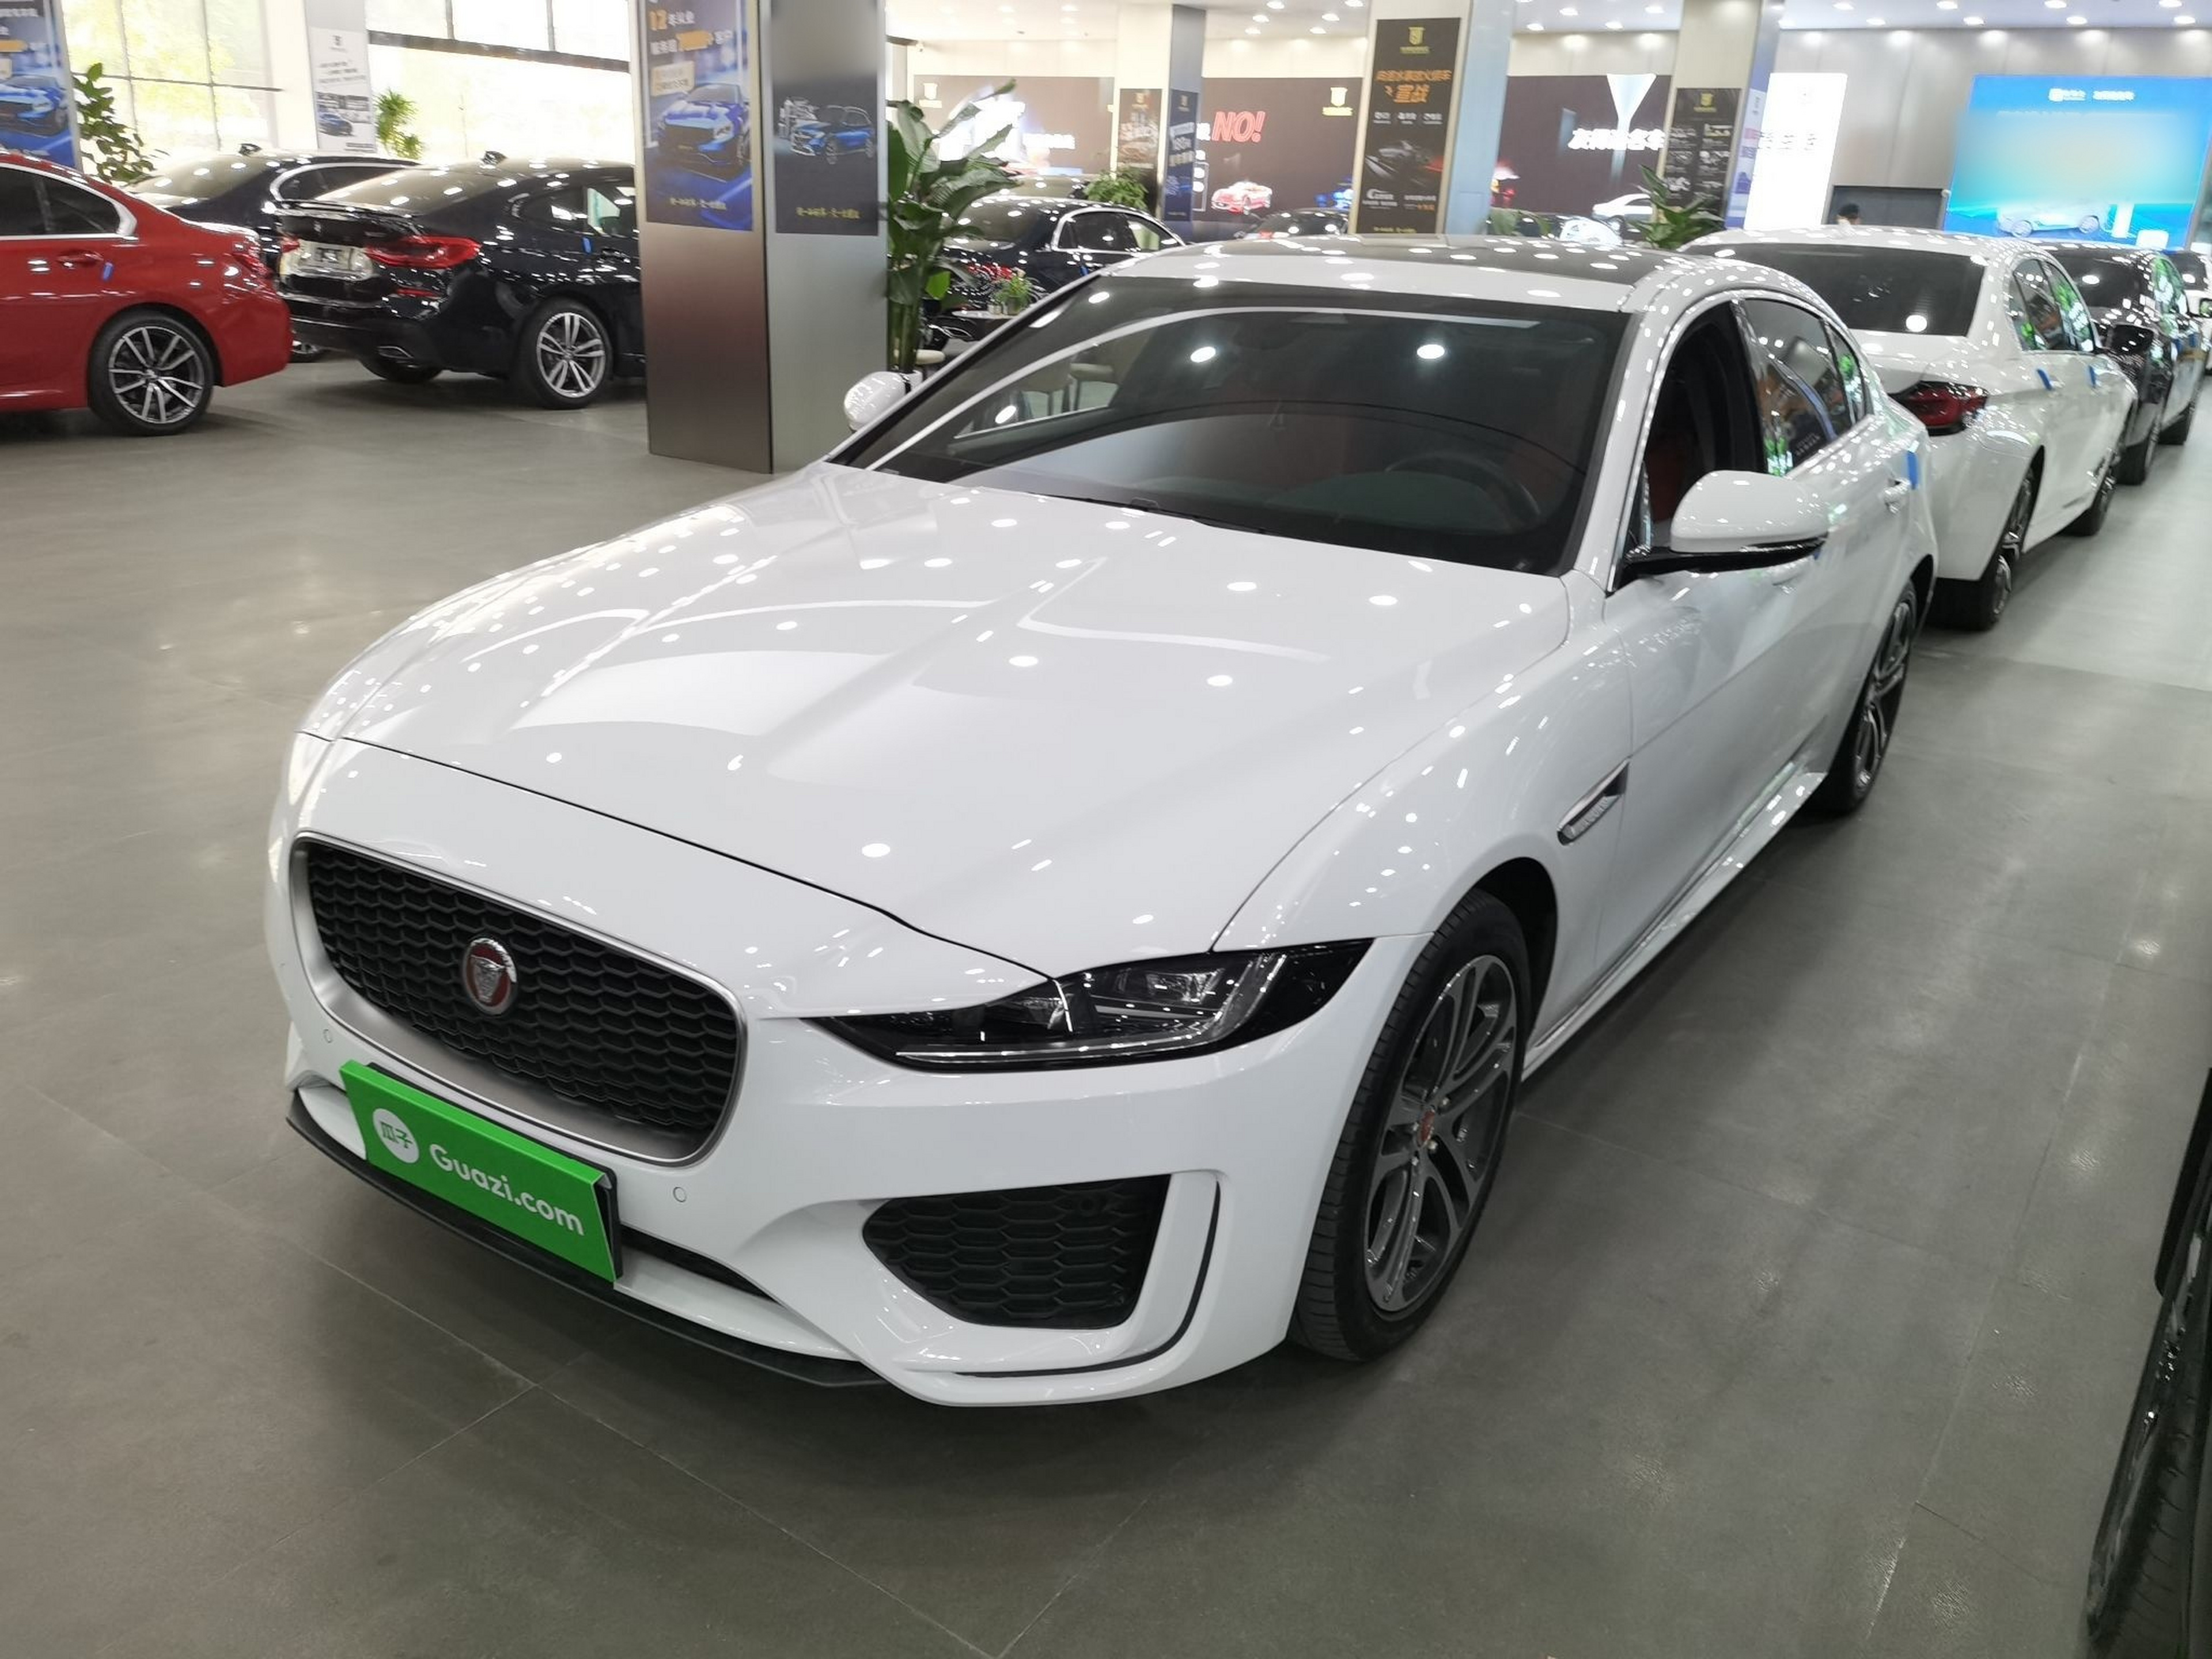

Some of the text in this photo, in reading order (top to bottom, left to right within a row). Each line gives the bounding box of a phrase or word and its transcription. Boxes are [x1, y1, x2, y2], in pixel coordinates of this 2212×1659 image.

[1211, 110, 1266, 143] NO!
[380, 1121, 413, 1149] 瓜子
[429, 1143, 585, 1236] Guazi.com
